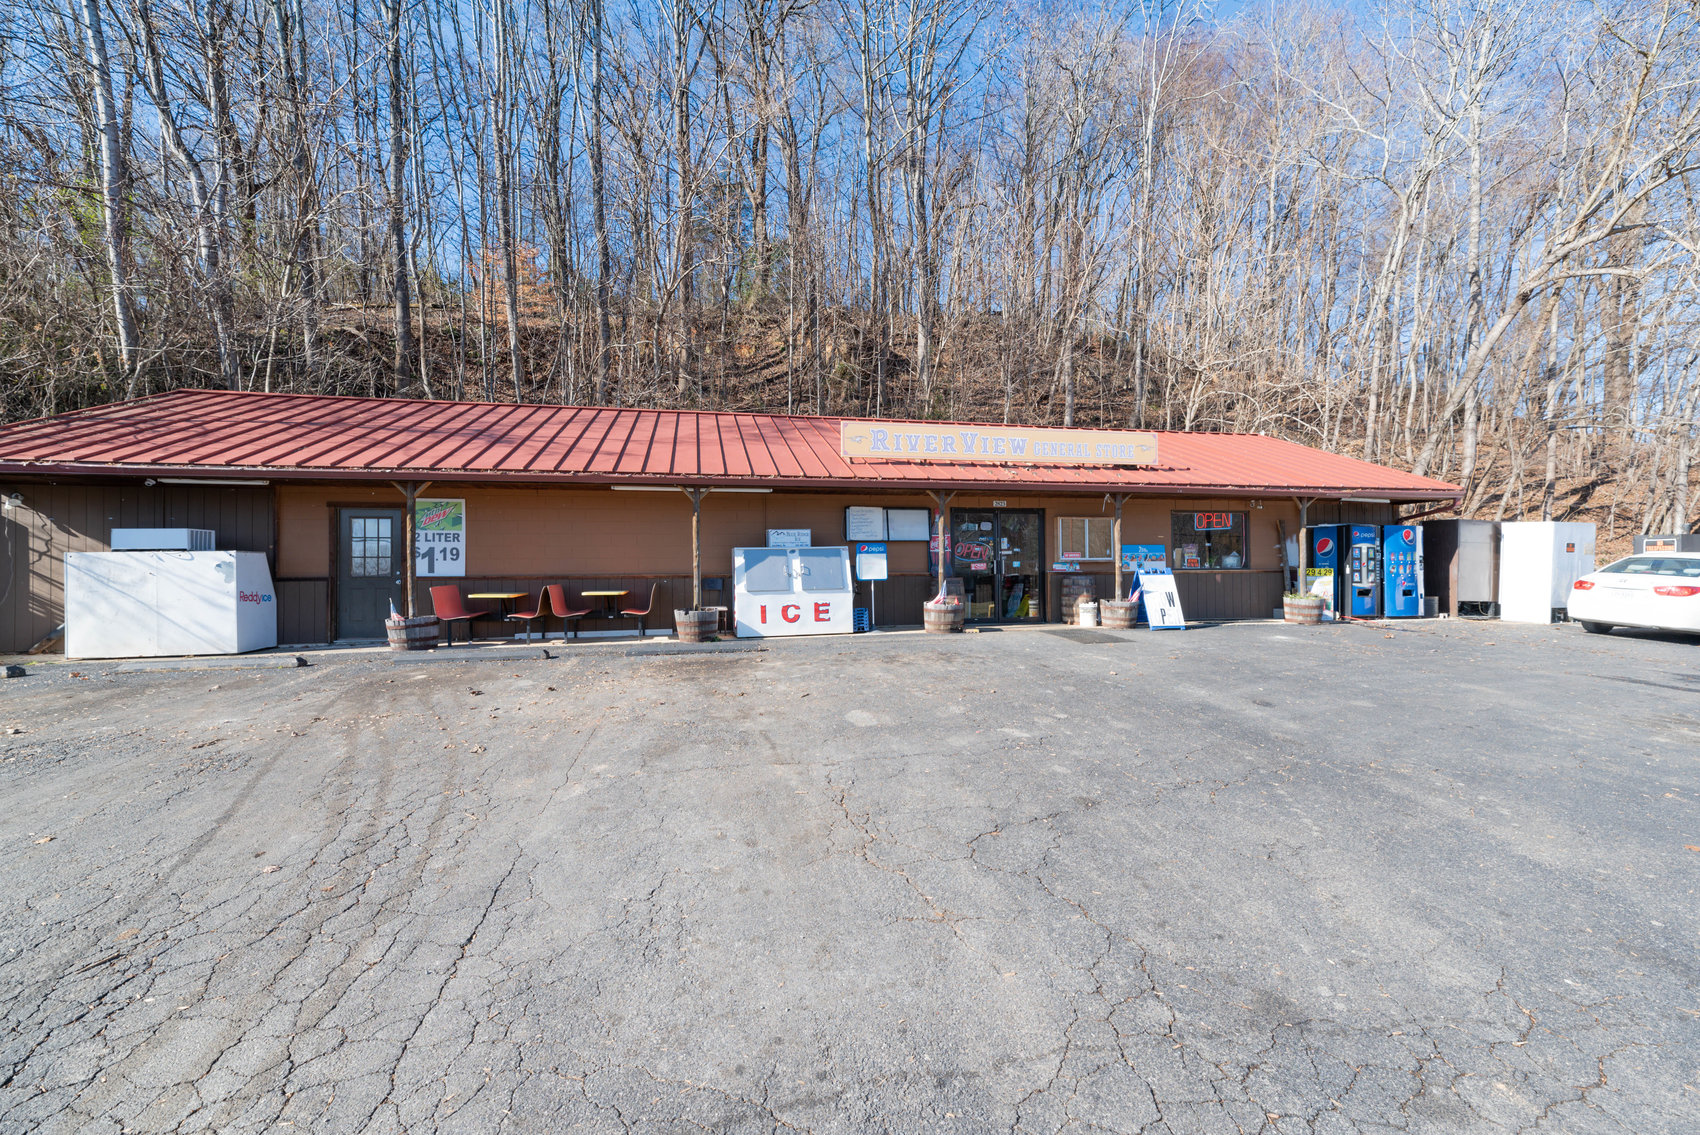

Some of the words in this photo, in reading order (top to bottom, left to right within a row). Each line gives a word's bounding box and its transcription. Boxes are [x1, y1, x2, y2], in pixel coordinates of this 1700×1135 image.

[1034, 441, 1091, 457] GENERAL
[1096, 443, 1135, 459] STORE
[1196, 513, 1231, 529] OPEN
[425, 533, 460, 542] LITER
[954, 542, 989, 560] OPEN
[760, 602, 831, 624] ICE
